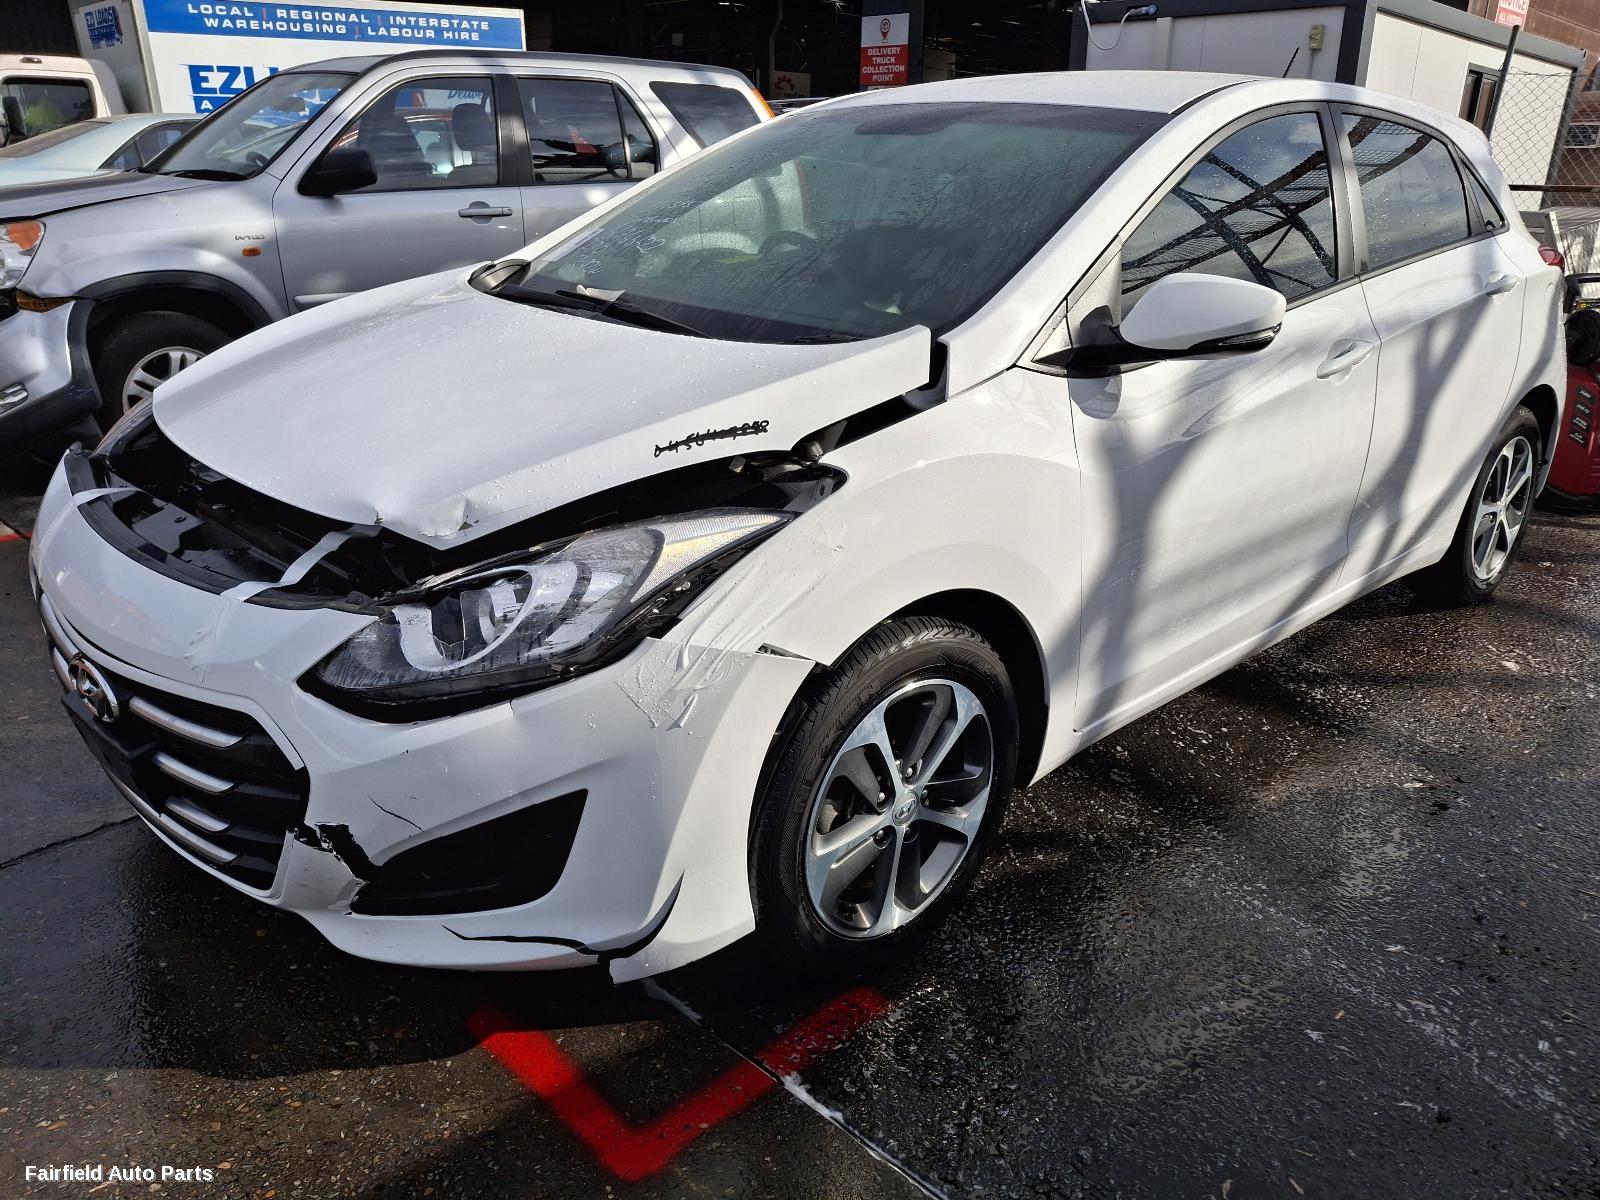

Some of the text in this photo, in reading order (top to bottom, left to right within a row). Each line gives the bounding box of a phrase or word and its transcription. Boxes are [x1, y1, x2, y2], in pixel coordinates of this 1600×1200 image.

[187, 3, 490, 30] LOCAL REGIONAL INTERSTATE
[203, 17, 480, 41] WAREHOUSING LABOUR HIRE
[867, 47, 901, 56] DELIVERY
[872, 56, 896, 64] TRUCK
[862, 65, 905, 74] COLLECTION
[872, 74, 894, 82] POINT
